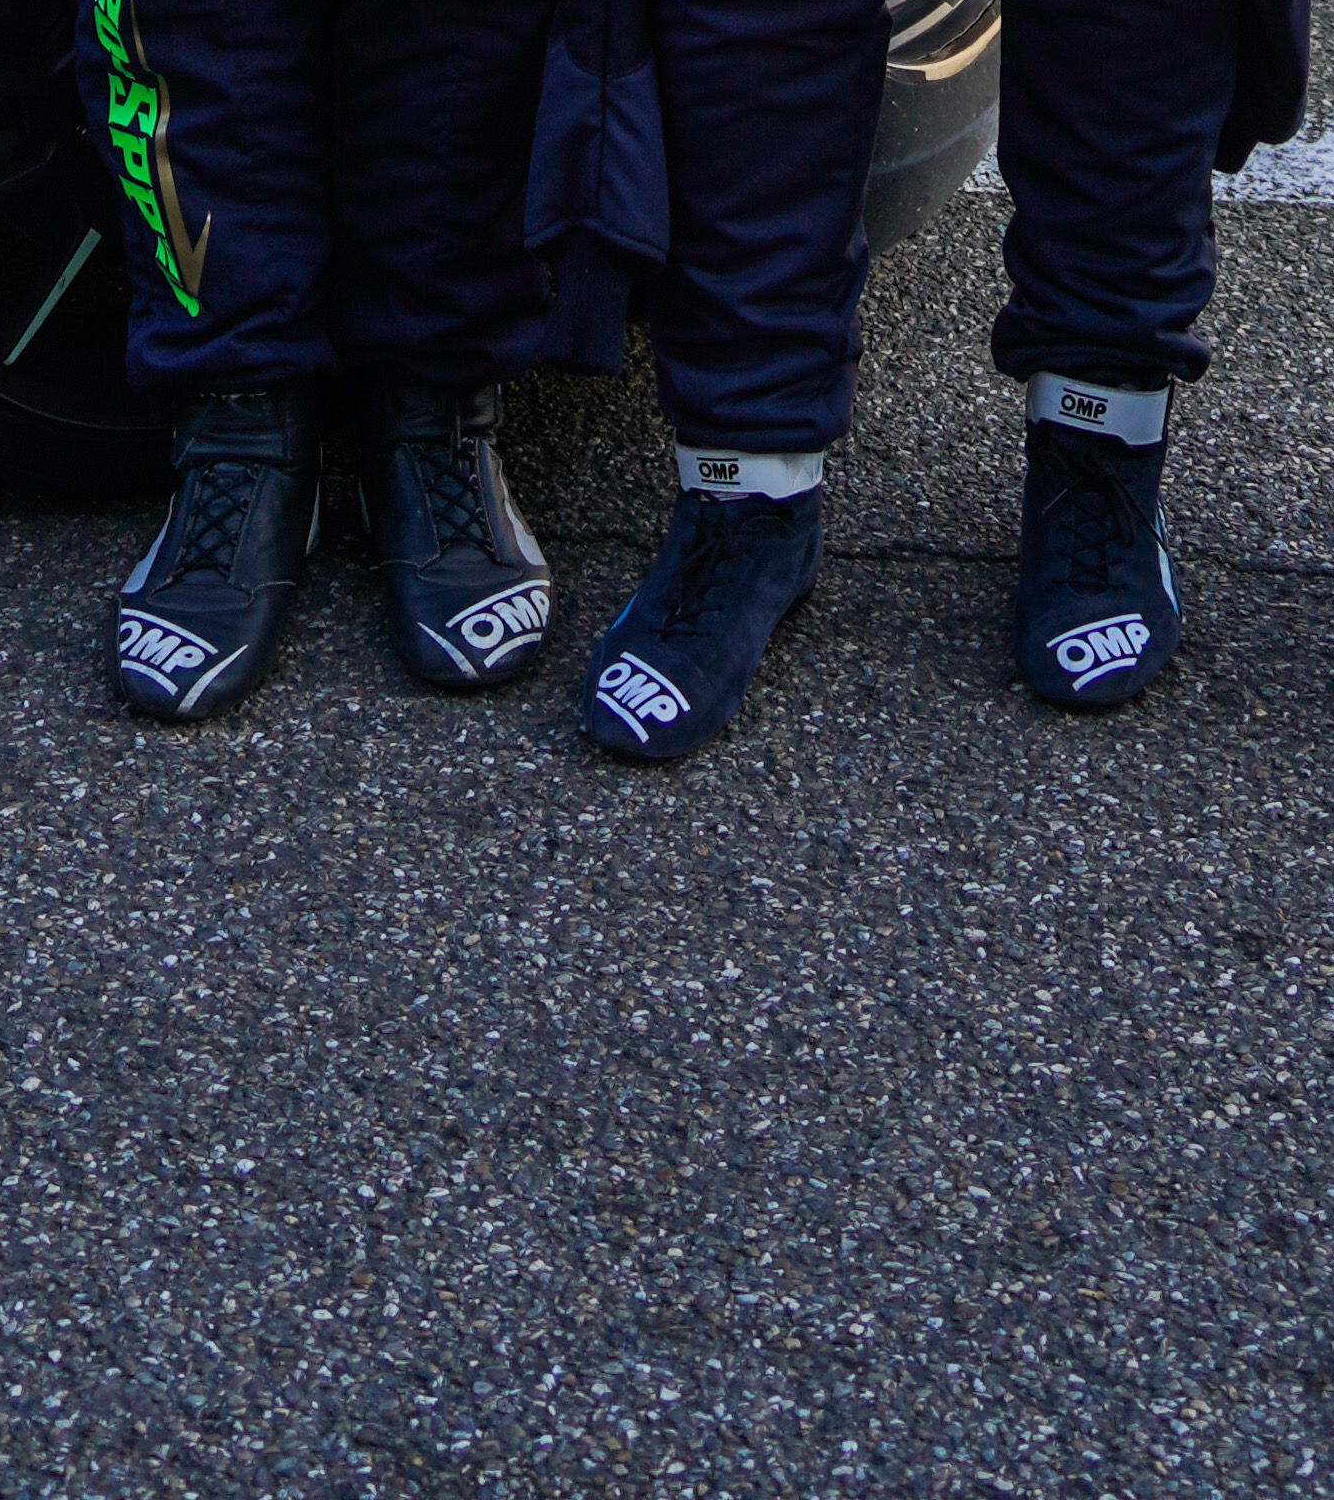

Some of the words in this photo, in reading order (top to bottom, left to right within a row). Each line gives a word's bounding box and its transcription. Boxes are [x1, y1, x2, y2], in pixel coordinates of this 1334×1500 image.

[1061, 393, 1108, 419] OMP
[697, 461, 741, 481] OMP
[119, 620, 206, 674] OMP
[1056, 620, 1151, 674] OMP
[598, 661, 679, 725] OMP
